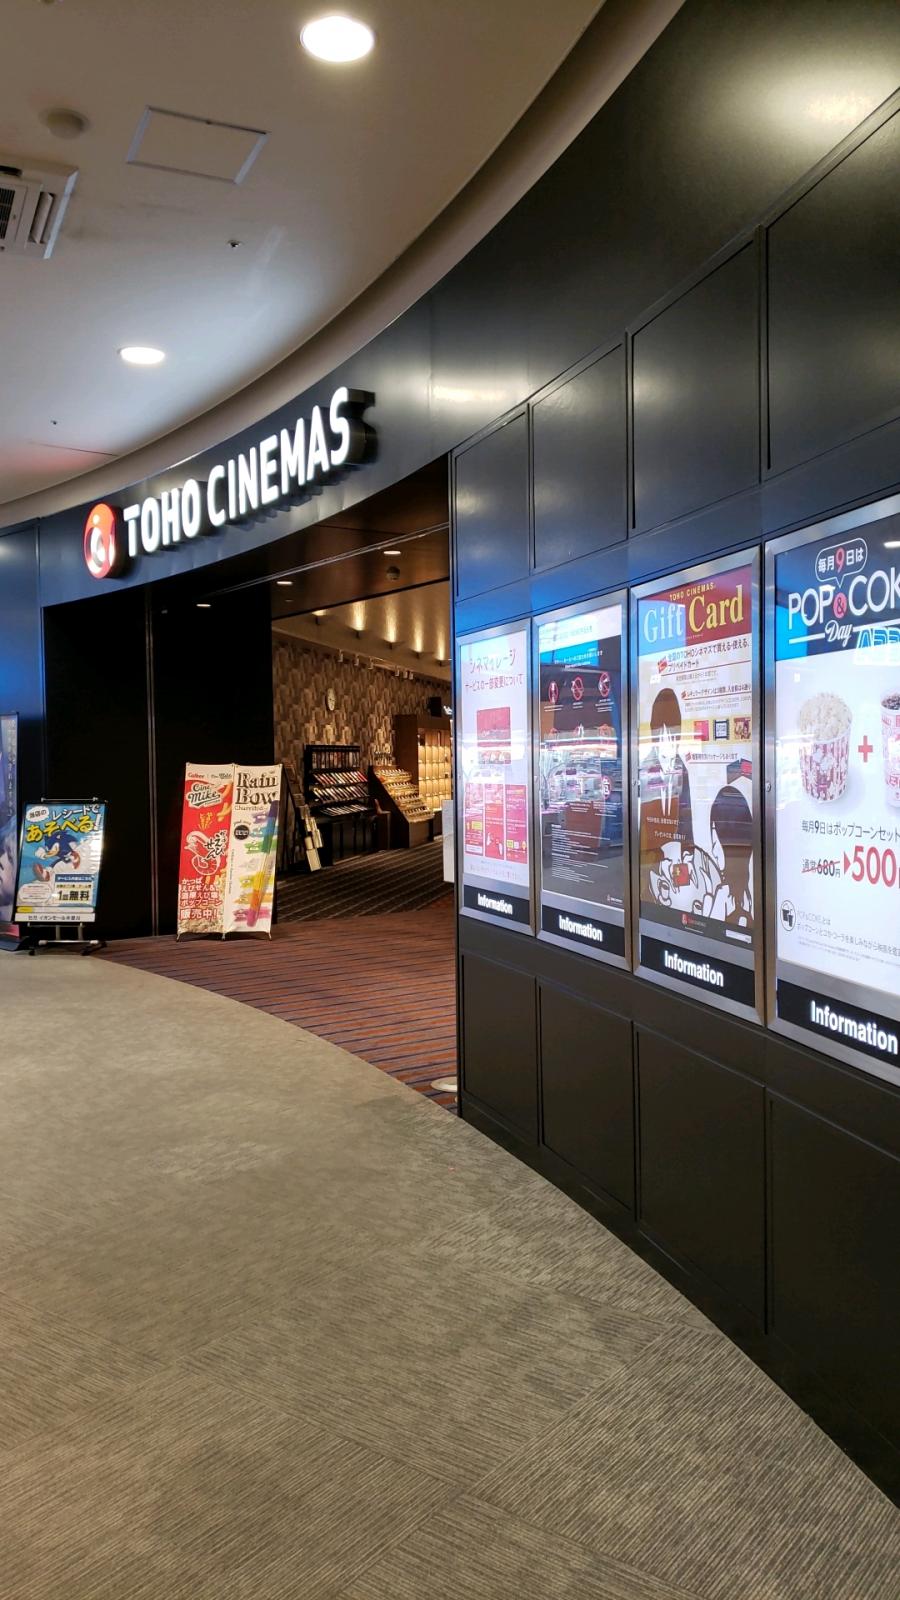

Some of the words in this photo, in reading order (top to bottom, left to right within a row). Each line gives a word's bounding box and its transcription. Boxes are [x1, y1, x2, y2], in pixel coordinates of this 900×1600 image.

[123, 478, 200, 558] TOHO
[207, 386, 350, 527] CINEMAS
[818, 547, 864, 574] 毎月9日は
[670, 592, 684, 601] TOHO
[686, 582, 714, 597] CINEMAS
[643, 603, 684, 643] Gift
[689, 584, 744, 633] Card
[825, 620, 853, 647] Day
[237, 772, 279, 788] Rain
[188, 791, 220, 803] Mike
[235, 788, 278, 805] Bow
[52, 804, 99, 820] レシートで
[477, 893, 513, 915] Information
[559, 915, 603, 942] Information
[664, 950, 724, 987] Information
[811, 1000, 898, 1054] Information
